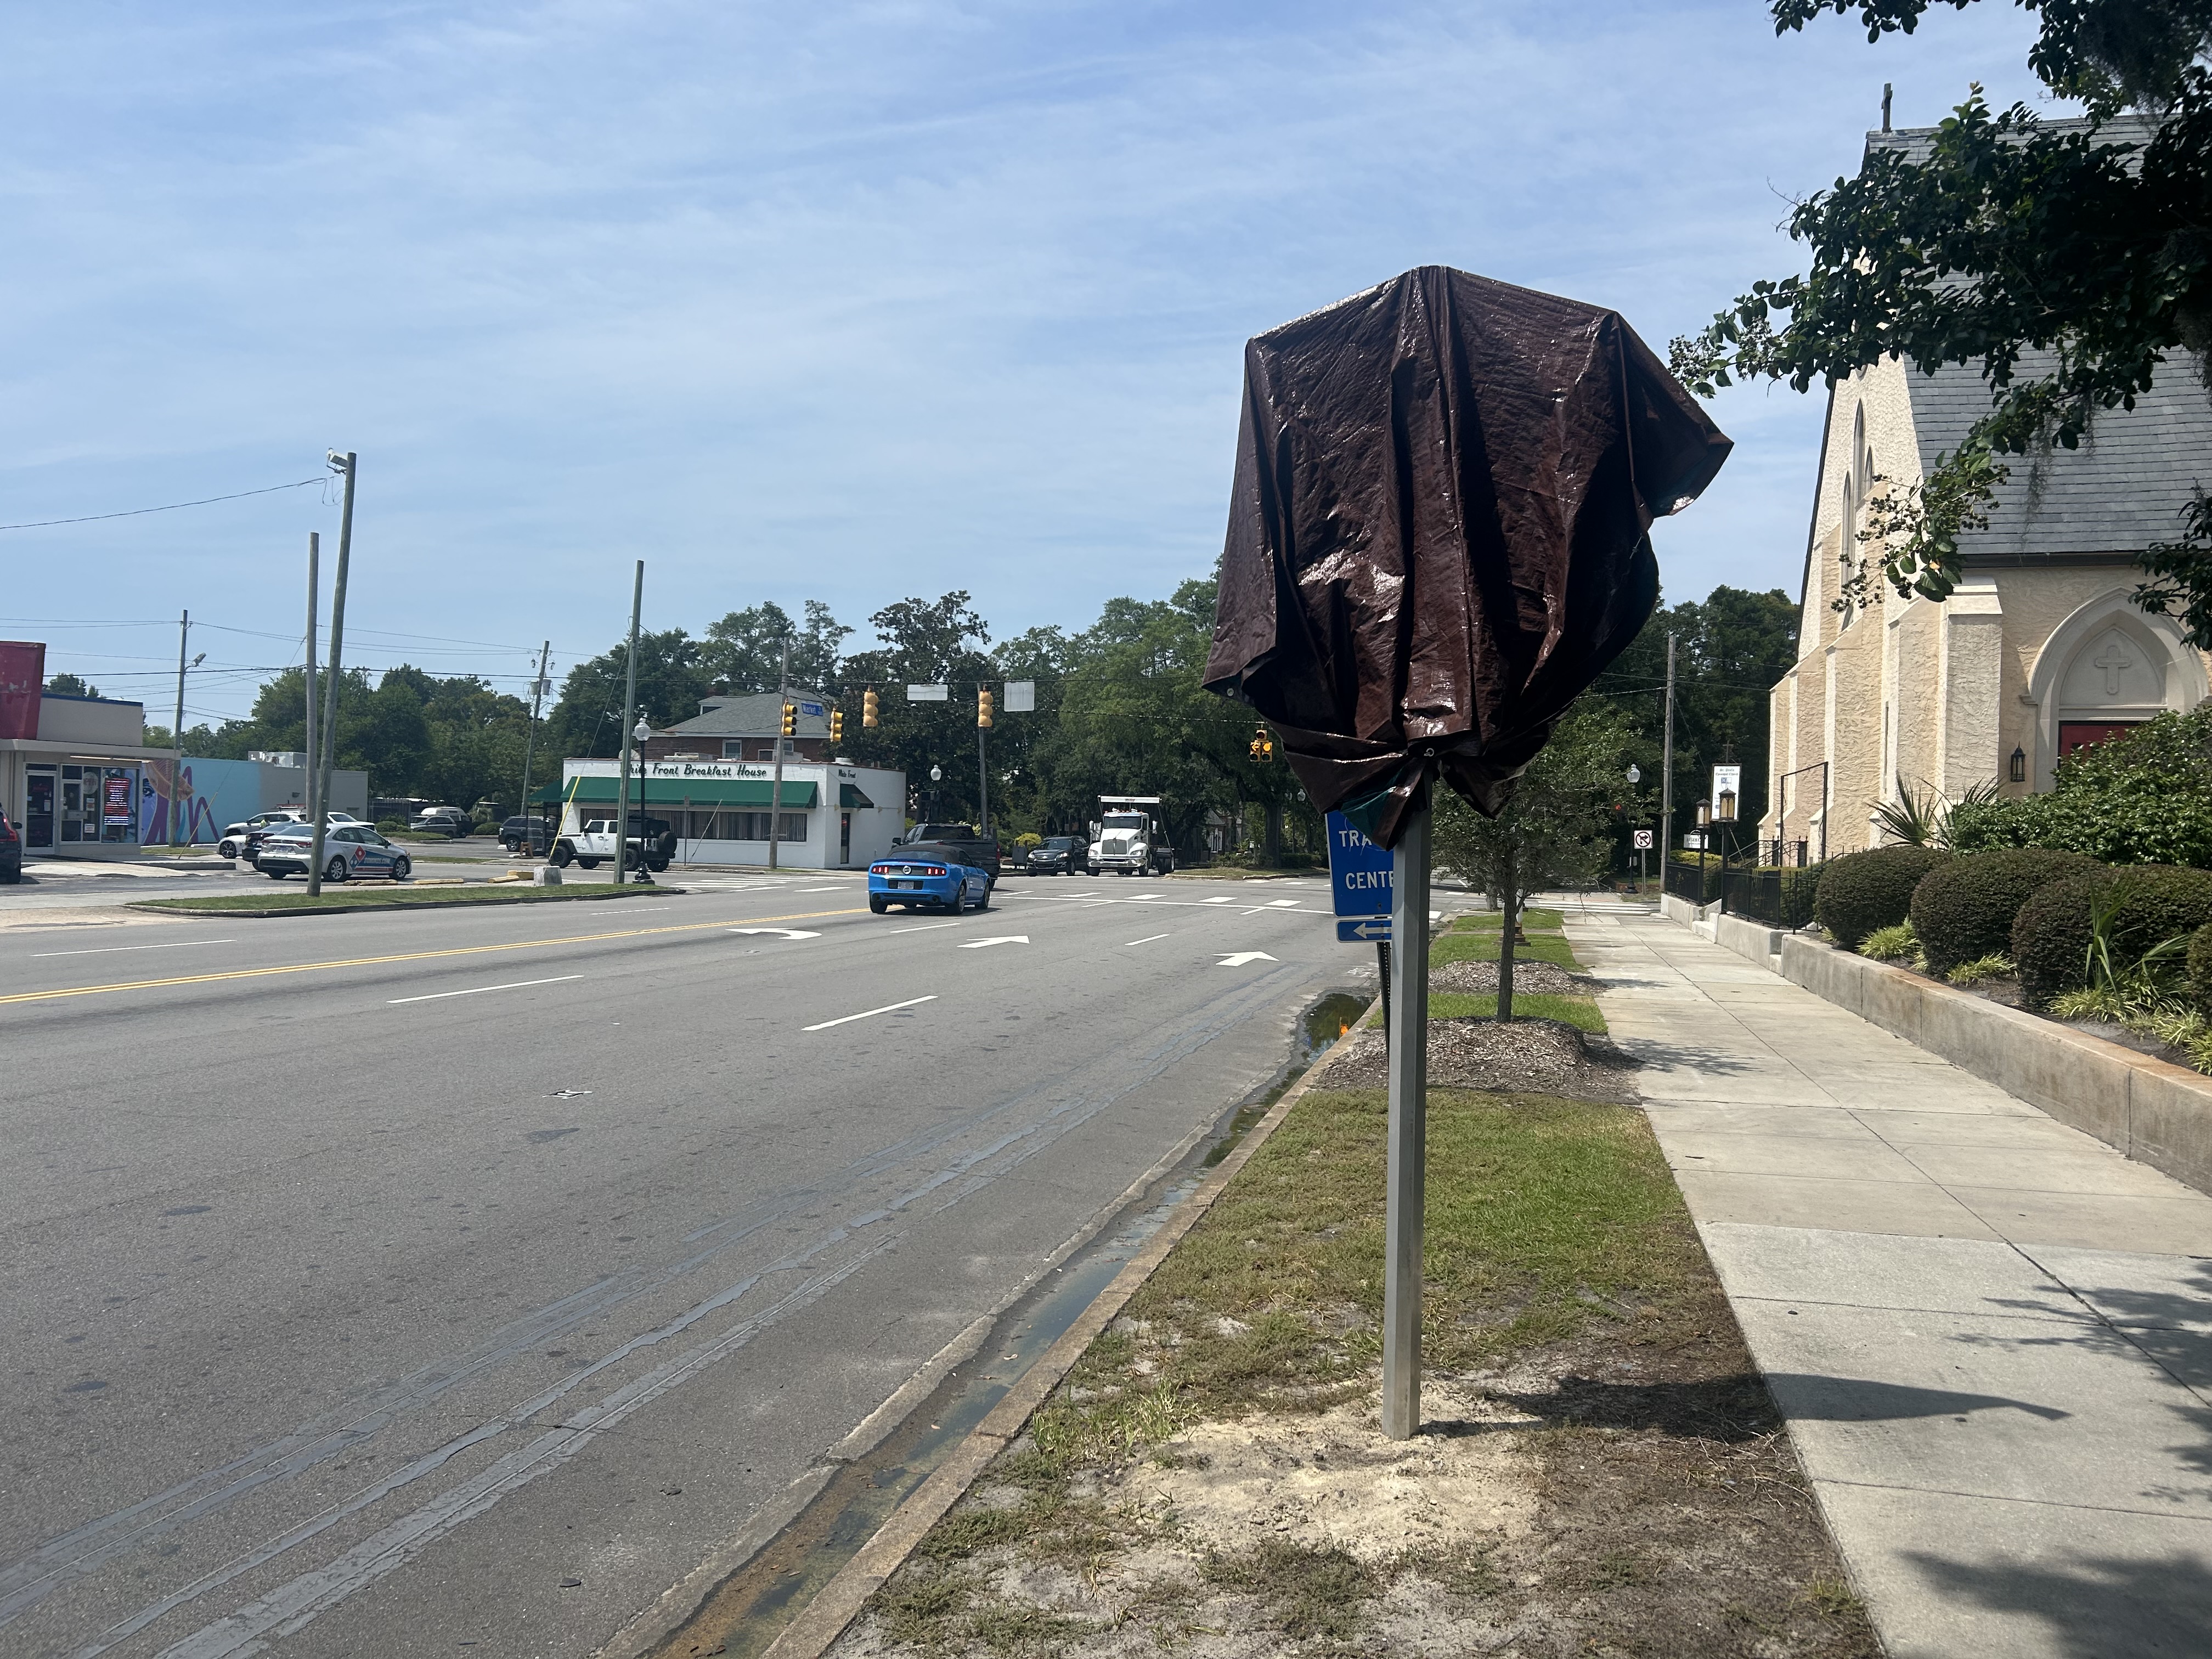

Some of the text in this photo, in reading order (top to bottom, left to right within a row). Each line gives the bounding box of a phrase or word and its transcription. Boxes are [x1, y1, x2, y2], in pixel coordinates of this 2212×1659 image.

[653, 763, 679, 775] Front
[684, 764, 732, 776] Breakfast
[737, 764, 766, 777] House
[1346, 871, 1393, 890] CENTE
